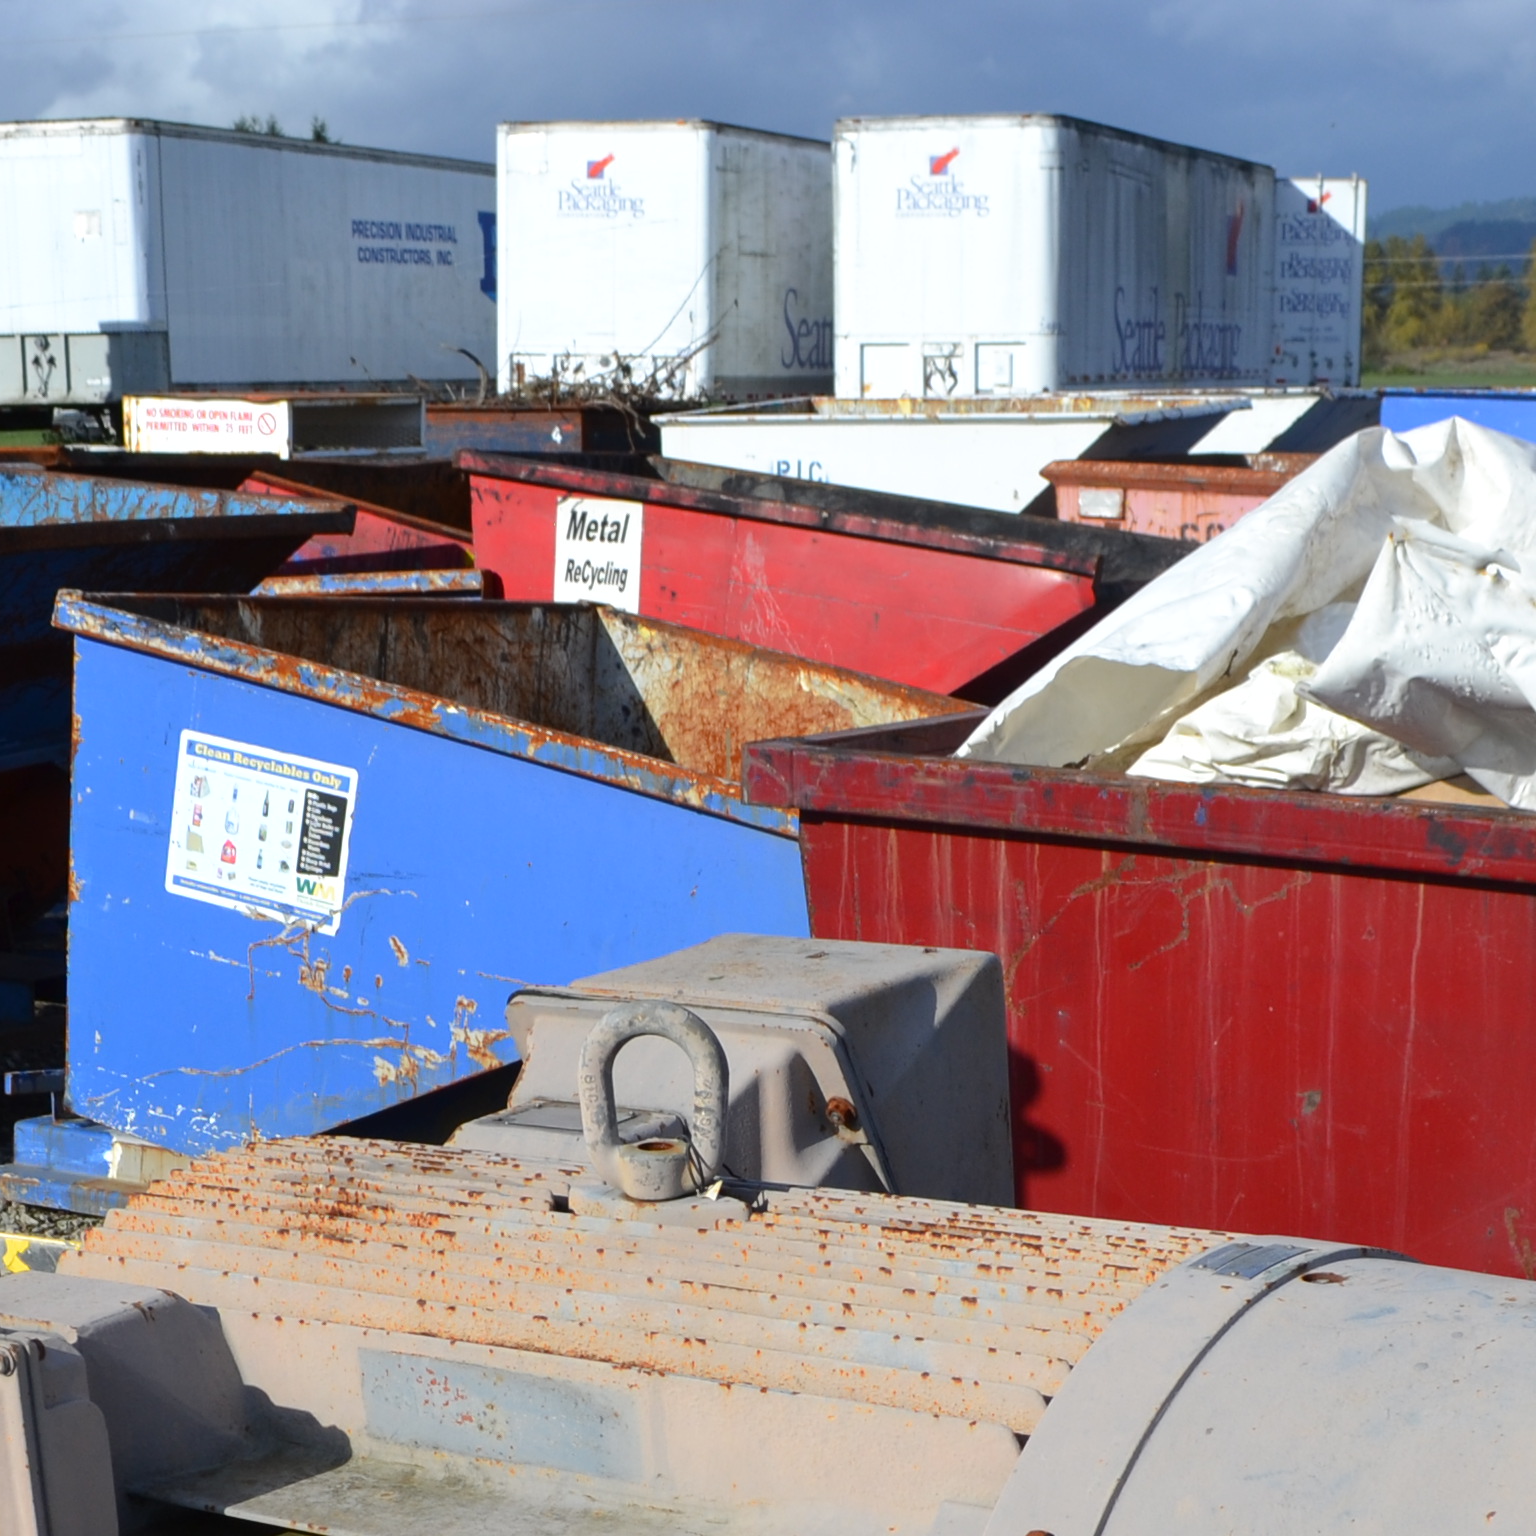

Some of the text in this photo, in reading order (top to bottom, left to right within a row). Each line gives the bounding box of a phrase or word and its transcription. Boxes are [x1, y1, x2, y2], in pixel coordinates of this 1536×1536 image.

[571, 177, 622, 198] Seattle
[910, 173, 964, 194] Seattle
[557, 189, 645, 219] Packaging
[896, 188, 990, 217] Packaging
[352, 219, 458, 244] PRECISION INDUSTRIAL
[358, 247, 434, 267] CONSTRUCTORS,
[1113, 286, 1165, 373] Seattle
[146, 408, 252, 421] NO SMOKING OR OPEN FLAME
[146, 422, 187, 431] PERMITTED
[192, 423, 219, 432] WITHIN
[239, 425, 253, 434] FEET
[566, 510, 630, 544] Metal
[565, 558, 628, 593] ReCycling
[194, 743, 231, 763] Clean
[232, 752, 310, 780] Recyclables
[312, 768, 343, 790] Only
